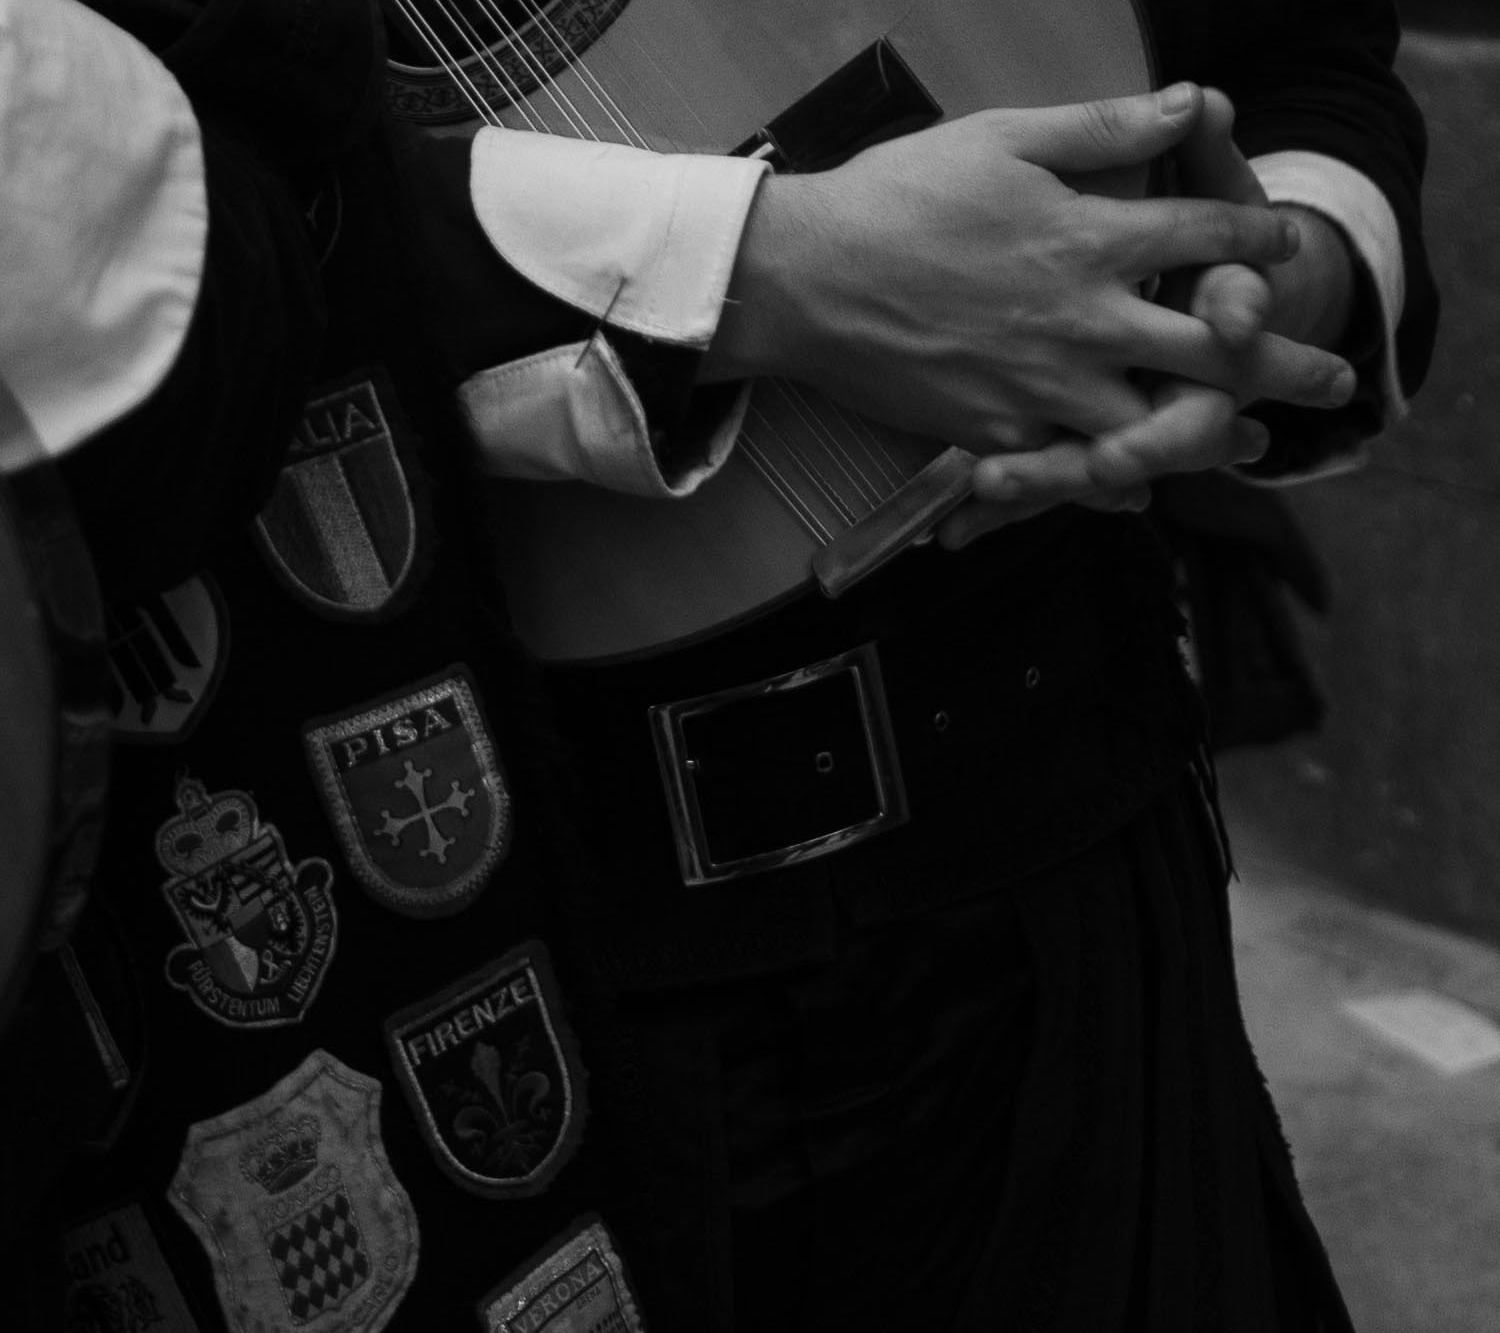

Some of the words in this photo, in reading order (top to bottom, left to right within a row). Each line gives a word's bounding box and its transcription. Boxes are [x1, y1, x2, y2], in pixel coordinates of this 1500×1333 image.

[341, 709, 453, 768] PISA
[407, 976, 536, 1066] FIRENZE
[513, 1261, 602, 1333] VERONA
